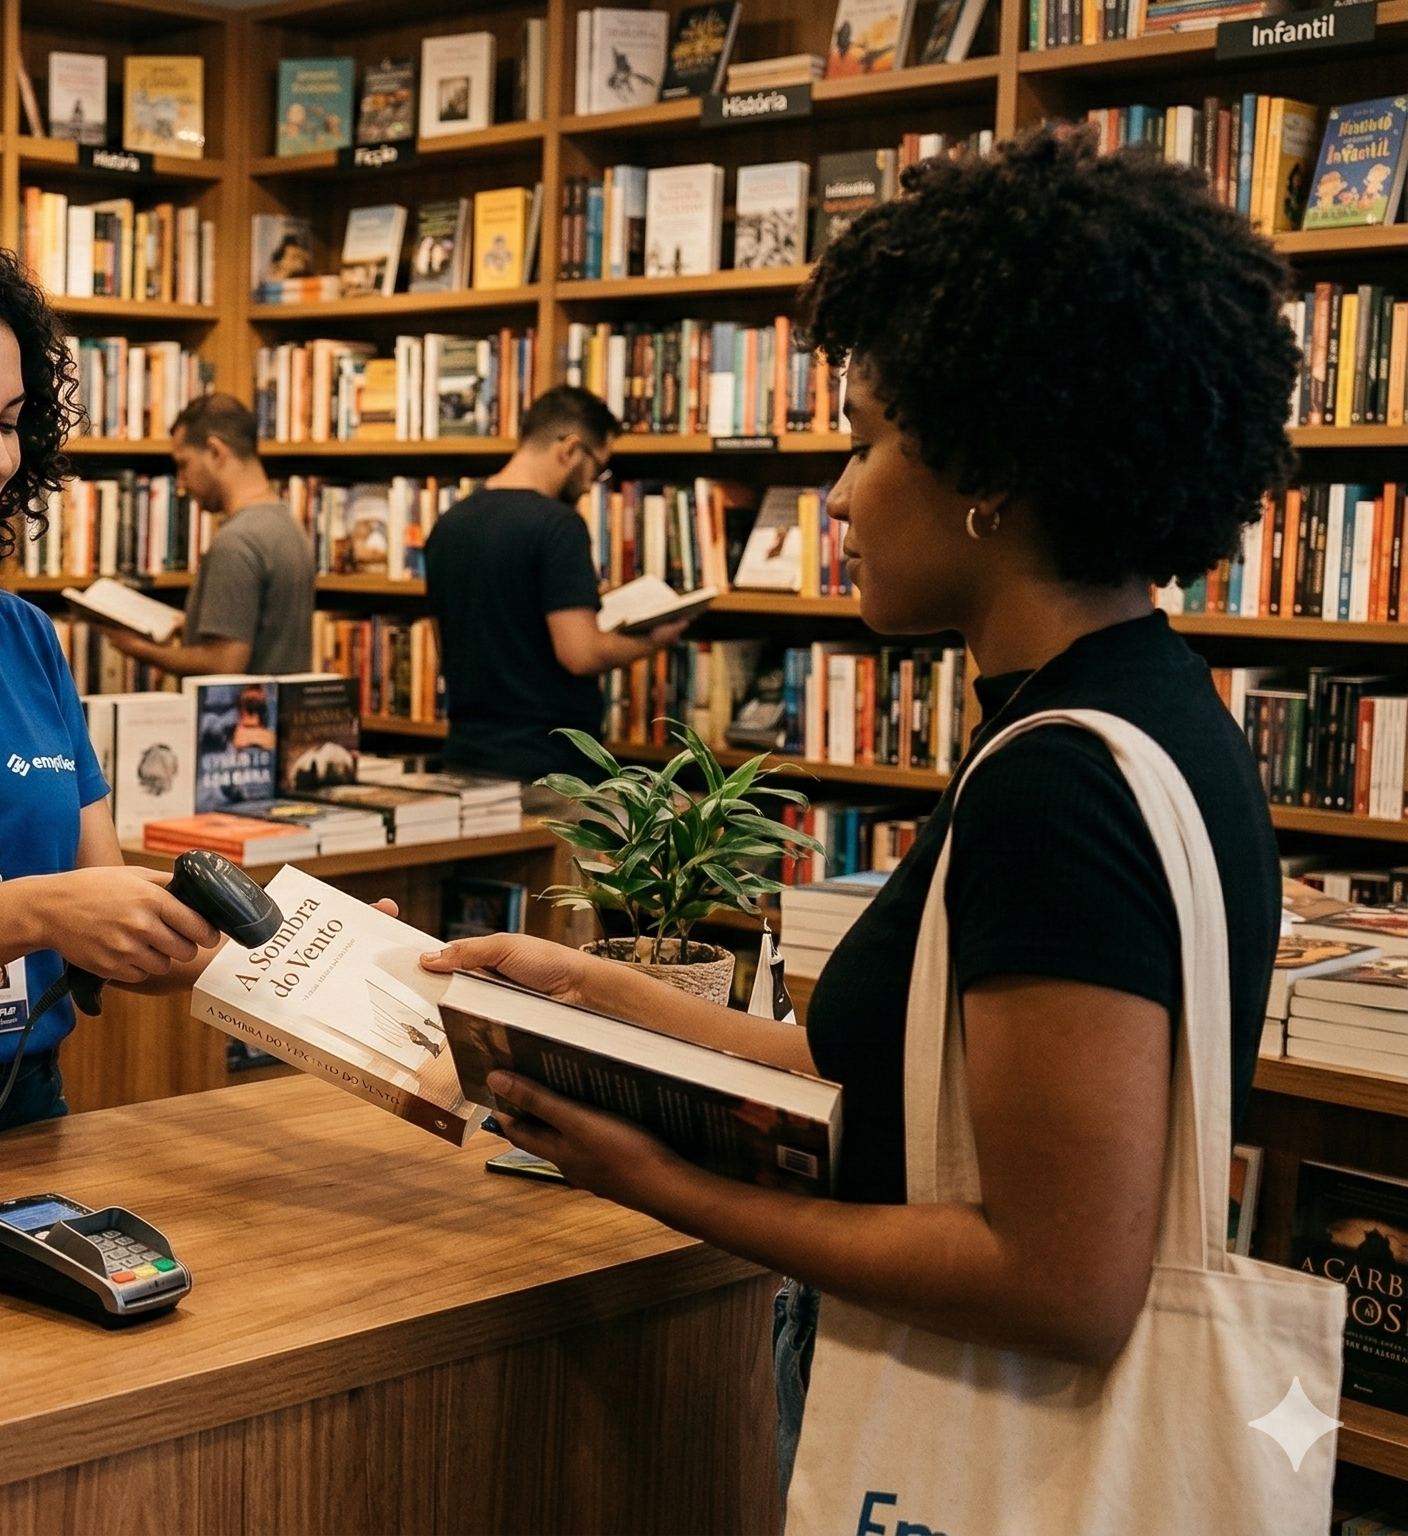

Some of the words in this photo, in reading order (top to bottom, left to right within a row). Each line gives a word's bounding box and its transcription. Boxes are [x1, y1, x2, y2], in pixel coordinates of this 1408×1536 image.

[1252, 13, 1335, 47] Infantil
[722, 91, 788, 118] História
[235, 973, 260, 992] A
[248, 897, 322, 972] Sombra
[269, 972, 300, 998] do
[285, 918, 344, 969] Vento
[266, 1034, 282, 1048] DO
[342, 1071, 359, 1085] DO
[1301, 1256, 1315, 1273] A
